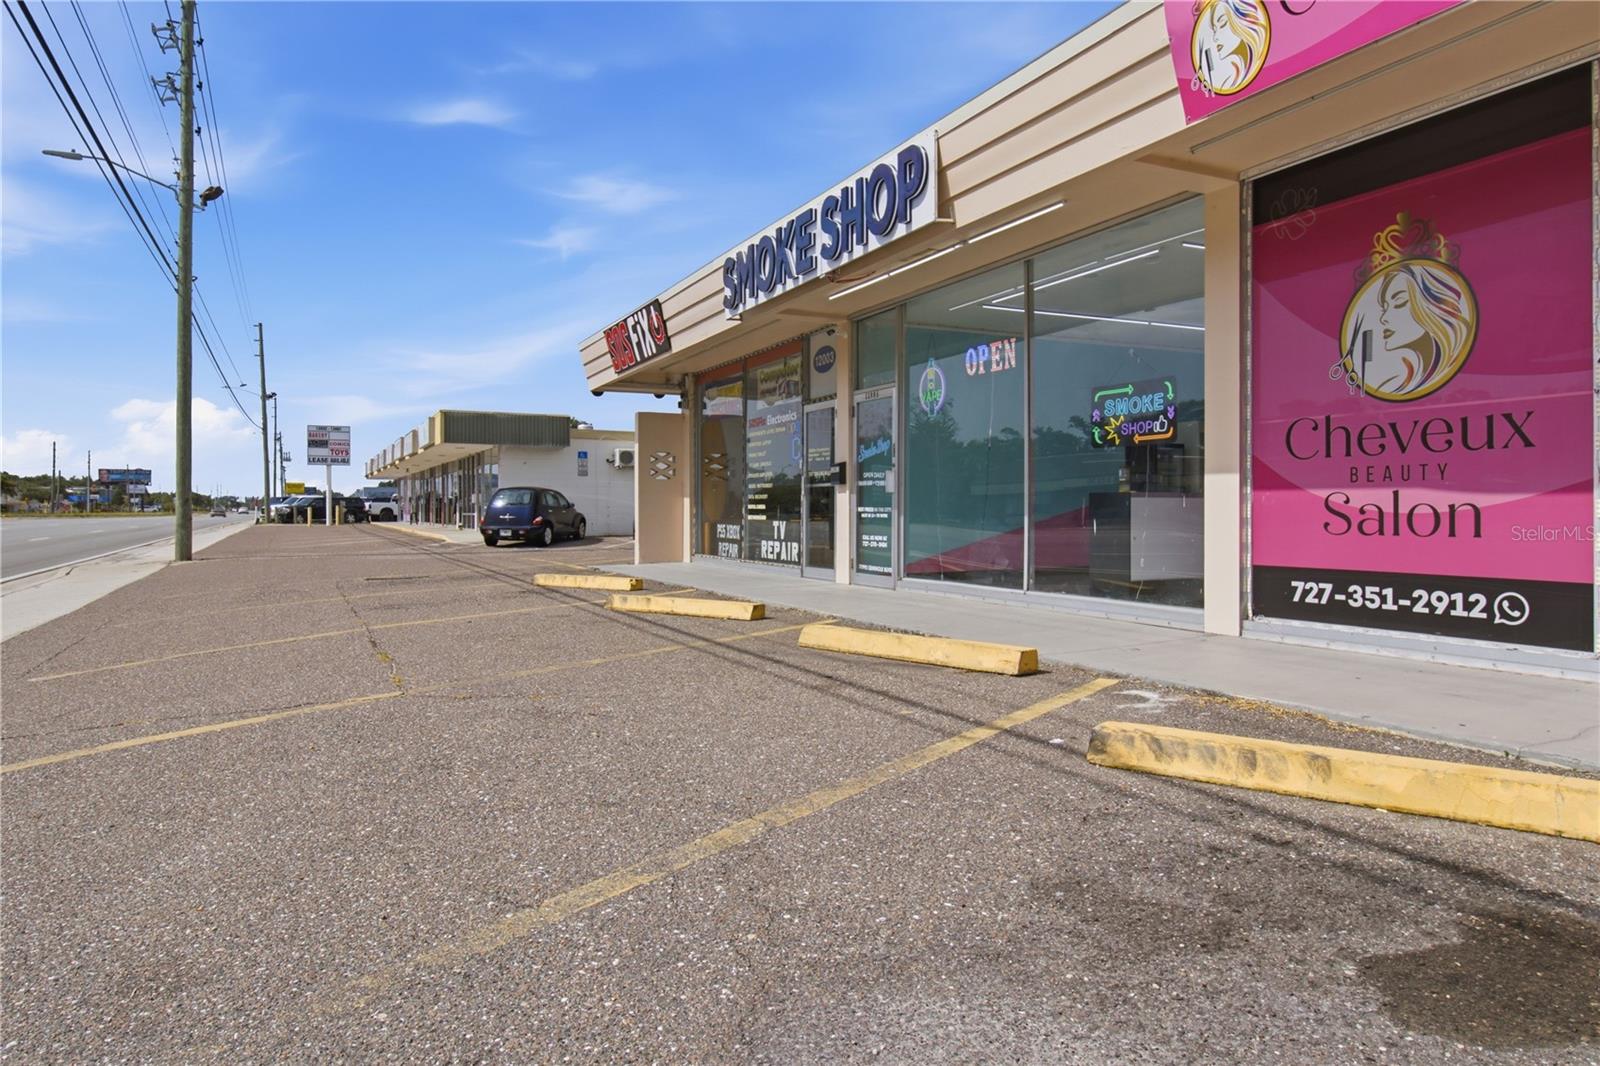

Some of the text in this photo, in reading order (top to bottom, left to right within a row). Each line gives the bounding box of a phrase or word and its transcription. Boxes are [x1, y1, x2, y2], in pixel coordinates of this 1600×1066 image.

[723, 144, 928, 310] SMOKE SHOP
[965, 337, 1017, 376] OPEN
[1104, 392, 1164, 416] SMOKE
[766, 410, 797, 426] Electronics
[1121, 420, 1153, 435] SHOP
[1285, 410, 1536, 460] Cheveux
[1350, 463, 1448, 483] BEAUTY
[1323, 489, 1482, 538] Salon
[772, 521, 787, 540] TV
[718, 542, 739, 558] REPAIR
[761, 540, 799, 562] REPAIR
[1290, 580, 1487, 619] 727-351-2912
